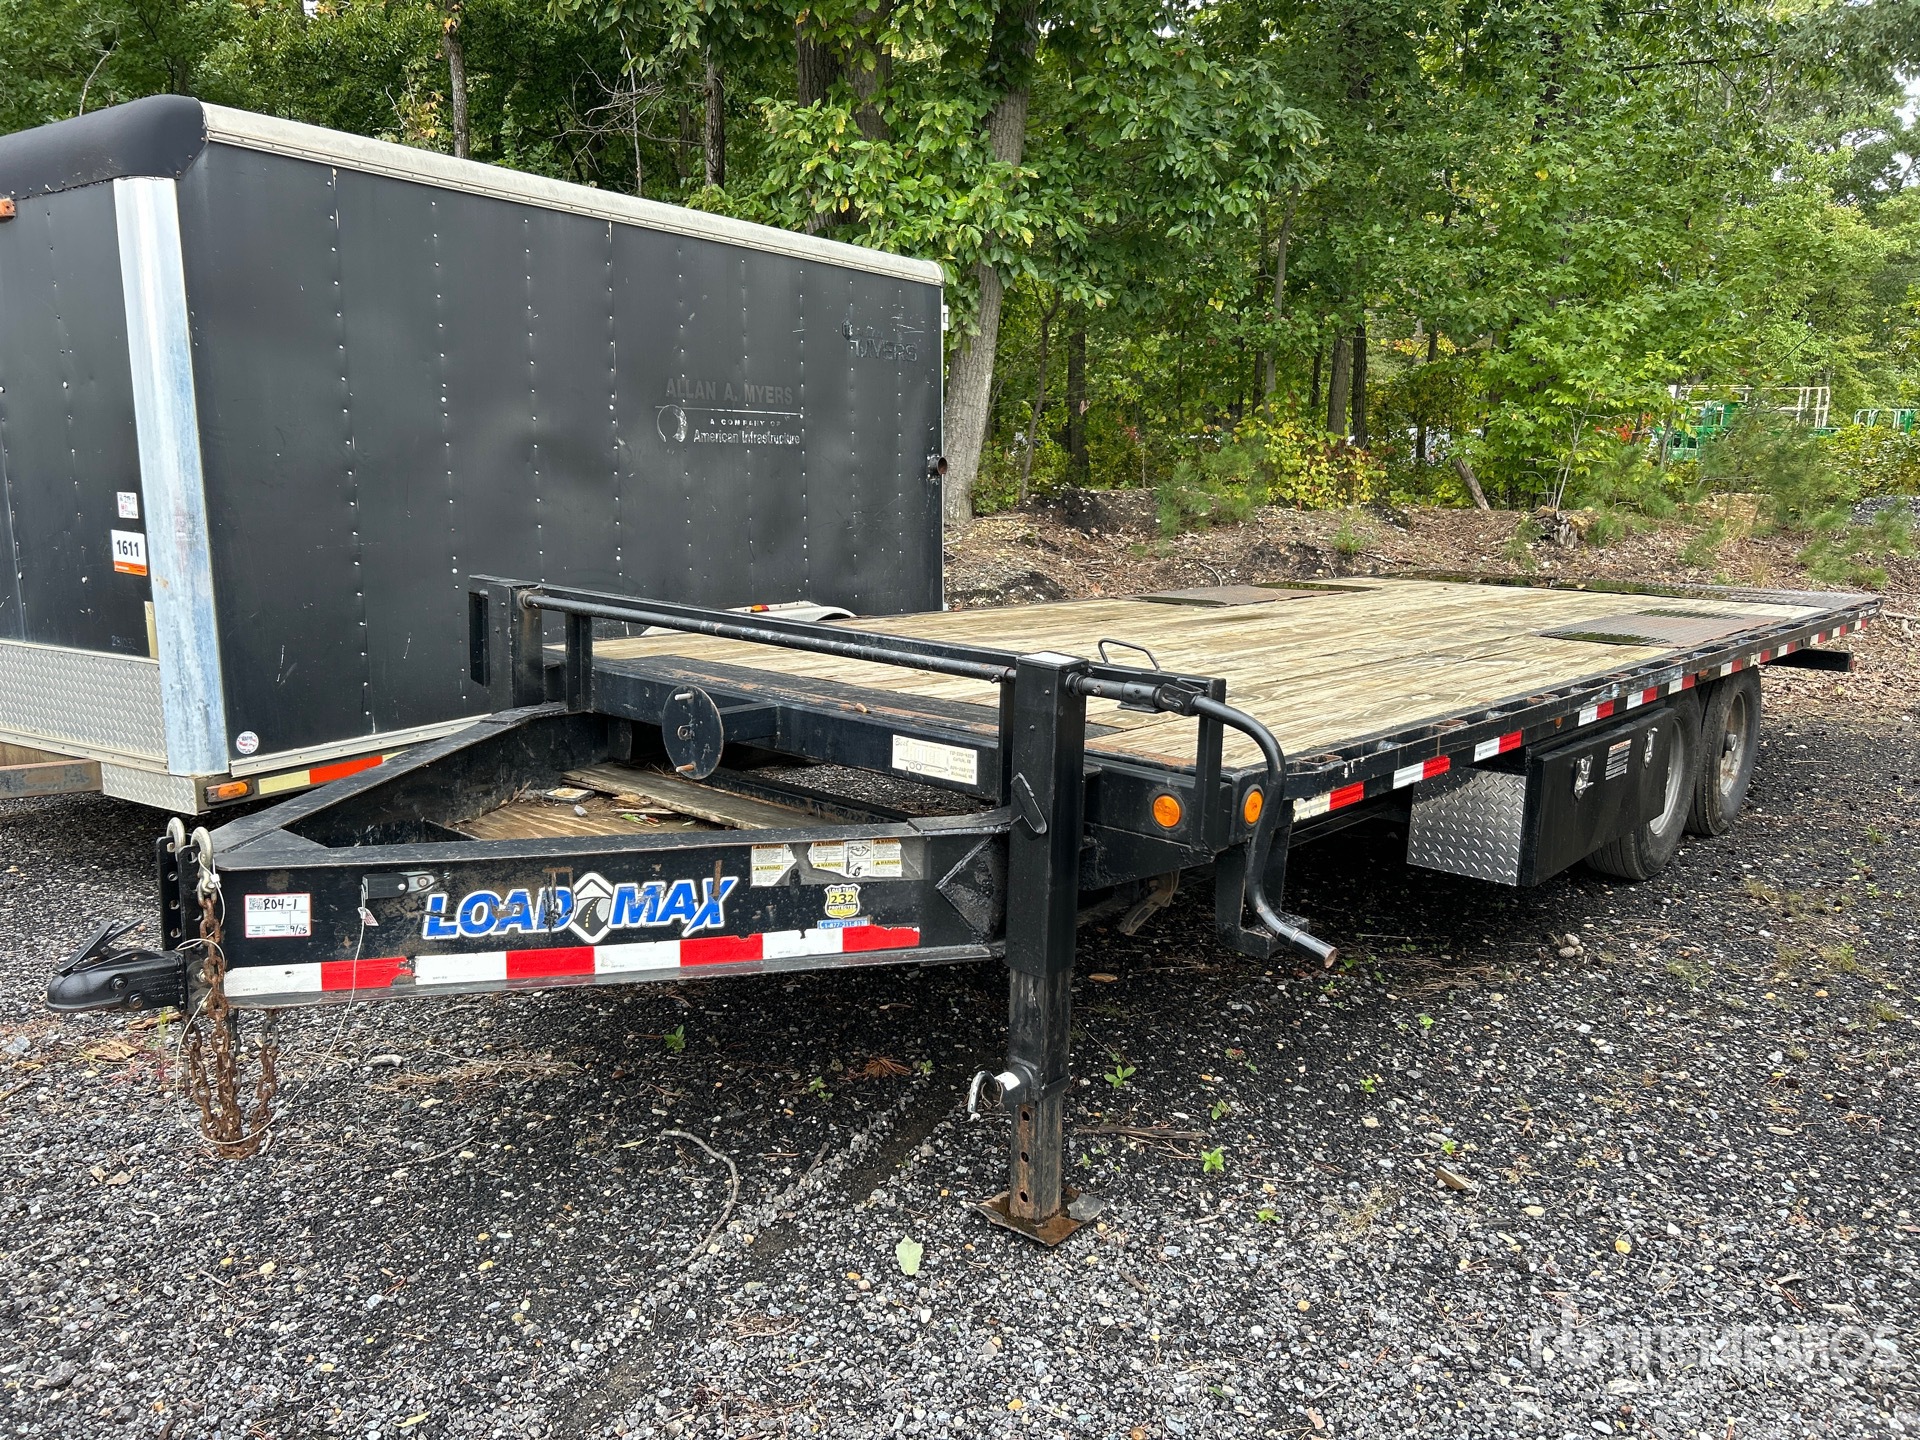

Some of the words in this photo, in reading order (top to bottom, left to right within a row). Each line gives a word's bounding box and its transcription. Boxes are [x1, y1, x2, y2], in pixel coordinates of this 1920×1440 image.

[665, 378, 717, 401] ALLAN
[744, 383, 794, 405] MYERS
[720, 419, 766, 427] COMPANY
[693, 429, 739, 443] American
[741, 430, 801, 445] Infrastructure
[116, 539, 140, 558] 1611
[830, 893, 854, 905] 232
[422, 886, 577, 940] LOAD
[606, 876, 739, 938] MAX
